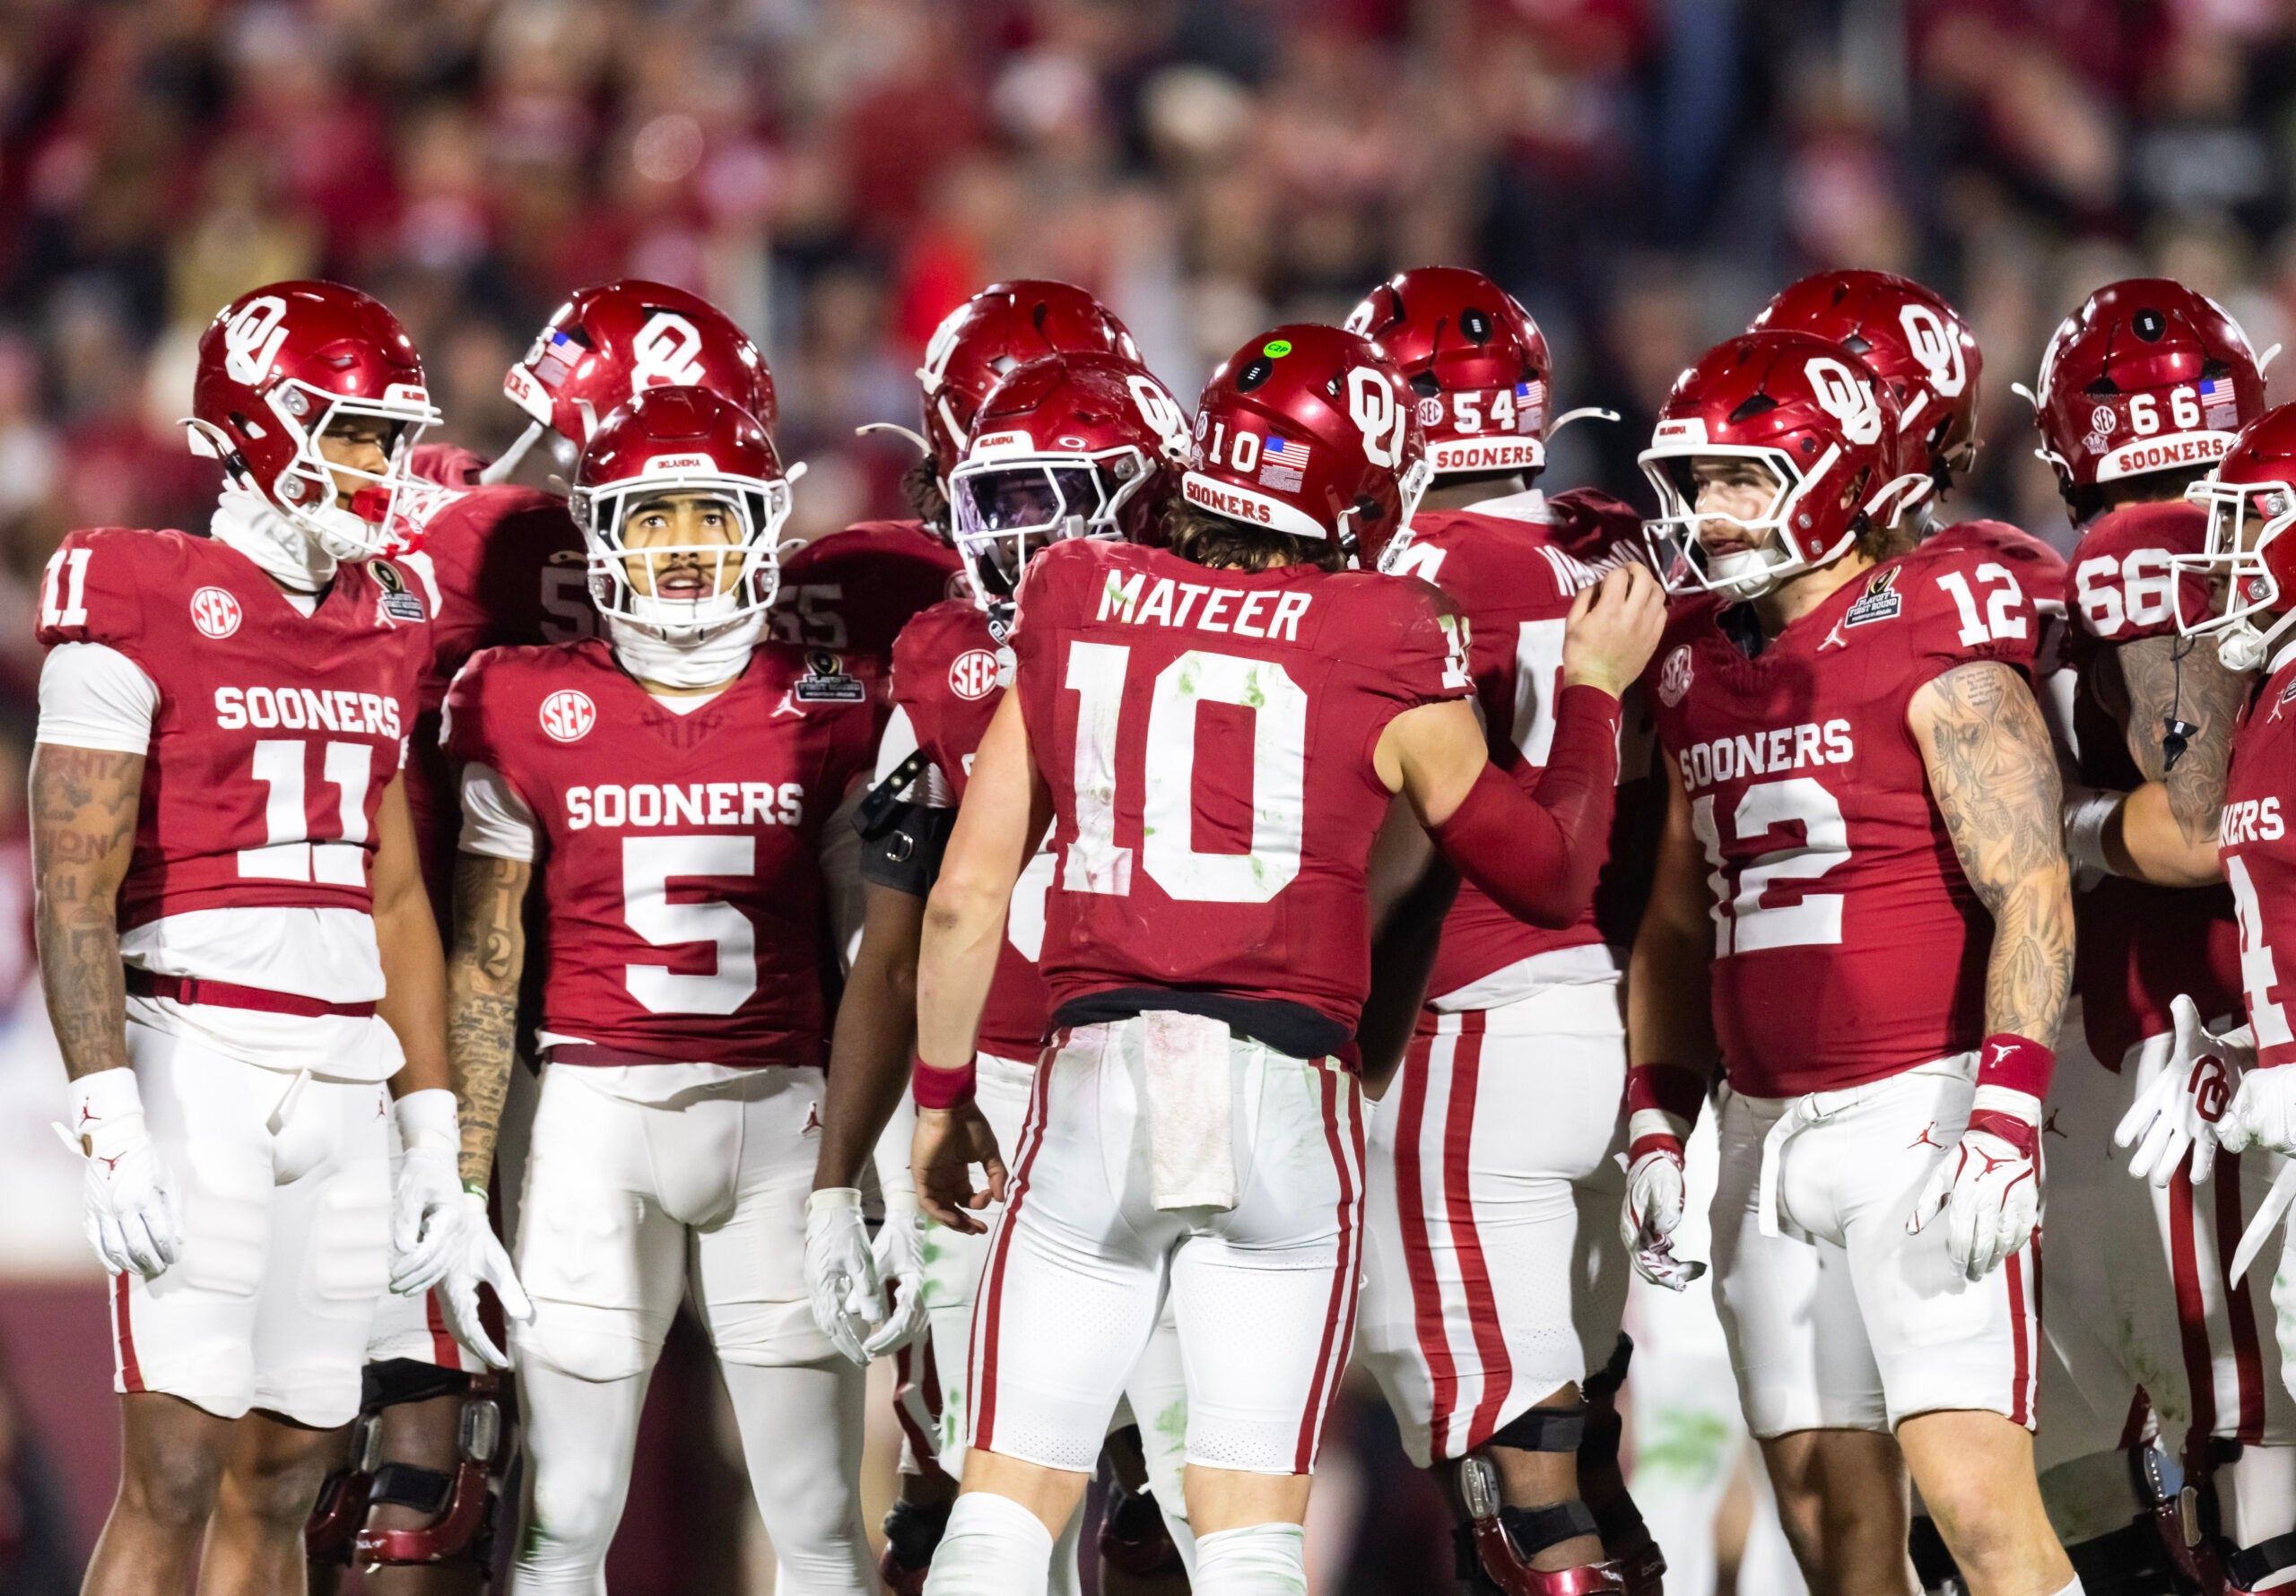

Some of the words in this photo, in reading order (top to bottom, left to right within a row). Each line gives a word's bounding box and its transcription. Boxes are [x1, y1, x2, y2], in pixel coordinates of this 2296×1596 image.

[1268, 343, 1289, 353] C2P
[1346, 366, 1405, 470] OU
[1420, 400, 1439, 424] SEC
[1453, 390, 1516, 434] 54
[2093, 407, 2115, 434] SEC
[2129, 386, 2200, 436] 66
[657, 458, 700, 469] OKLAHOMA
[1209, 422, 1260, 473] 10
[1437, 446, 1534, 468] SOONERS
[2119, 438, 2224, 473] SOONERS
[1187, 480, 1271, 524] SOONERS
[42, 548, 92, 628] 11
[196, 591, 239, 635] SEC
[1096, 568, 1312, 642] MATEER
[1936, 562, 2027, 647] 12
[2074, 548, 2178, 636] 66
[953, 654, 996, 697] SEC
[215, 686, 402, 742] SOONERS
[544, 693, 592, 739] SEC
[1064, 640, 1309, 904] 10
[1679, 718, 1854, 793] SOONERS
[237, 739, 374, 881] 11
[566, 782, 804, 831] SOONERS
[1692, 776, 1853, 960] 12
[622, 836, 757, 1014] 5
